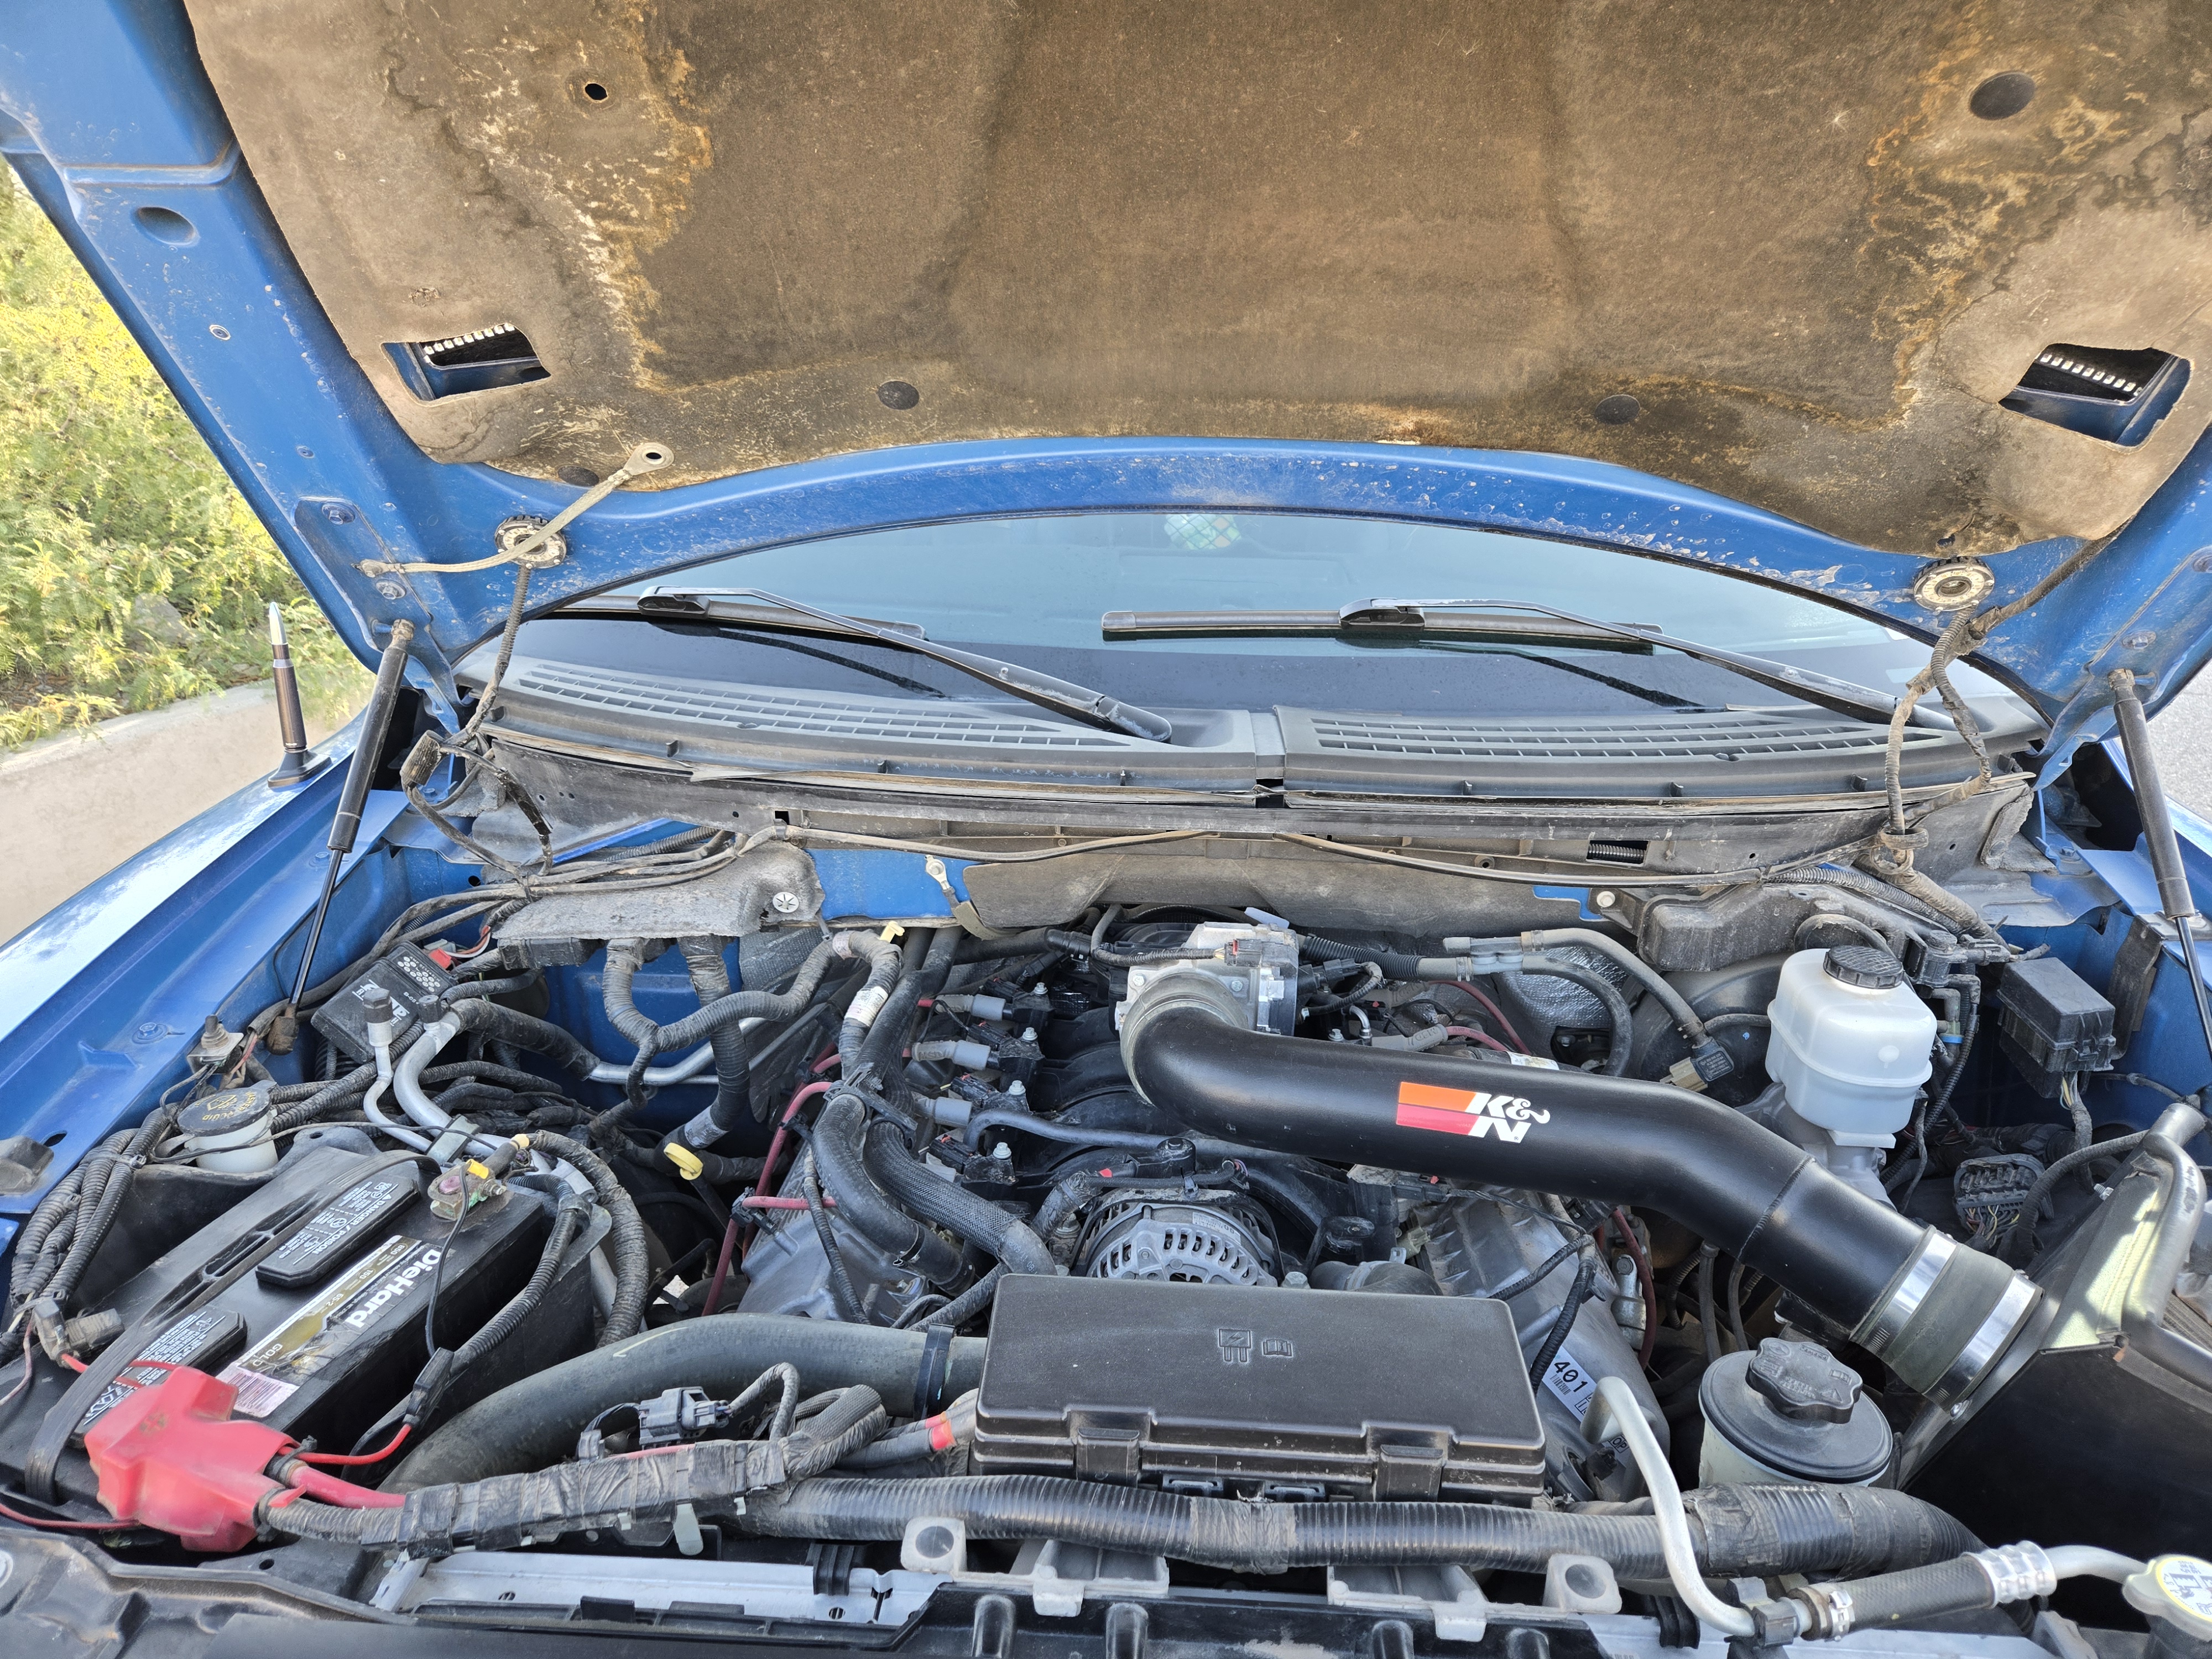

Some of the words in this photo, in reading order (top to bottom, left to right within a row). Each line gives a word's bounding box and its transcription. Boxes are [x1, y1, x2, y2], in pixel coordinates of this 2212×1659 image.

[418, 963, 441, 982] RESEARCH
[237, 1091, 256, 1112] WASHER
[201, 1110, 234, 1120] FLUID
[349, 1200, 385, 1225] DANGER
[311, 1229, 347, 1255] POISON
[389, 1242, 405, 1257] 850
[358, 1266, 374, 1281] 150
[343, 1248, 444, 1329] DieHard
[325, 1291, 345, 1308] 65-2
[165, 1328, 190, 1347] MEDICAL
[179, 1329, 195, 1341] WITH
[181, 1330, 201, 1344] FLUSH
[169, 1343, 184, 1354] EYES
[251, 1341, 283, 1369] GOLD
[1551, 1355, 1588, 1395] 401
